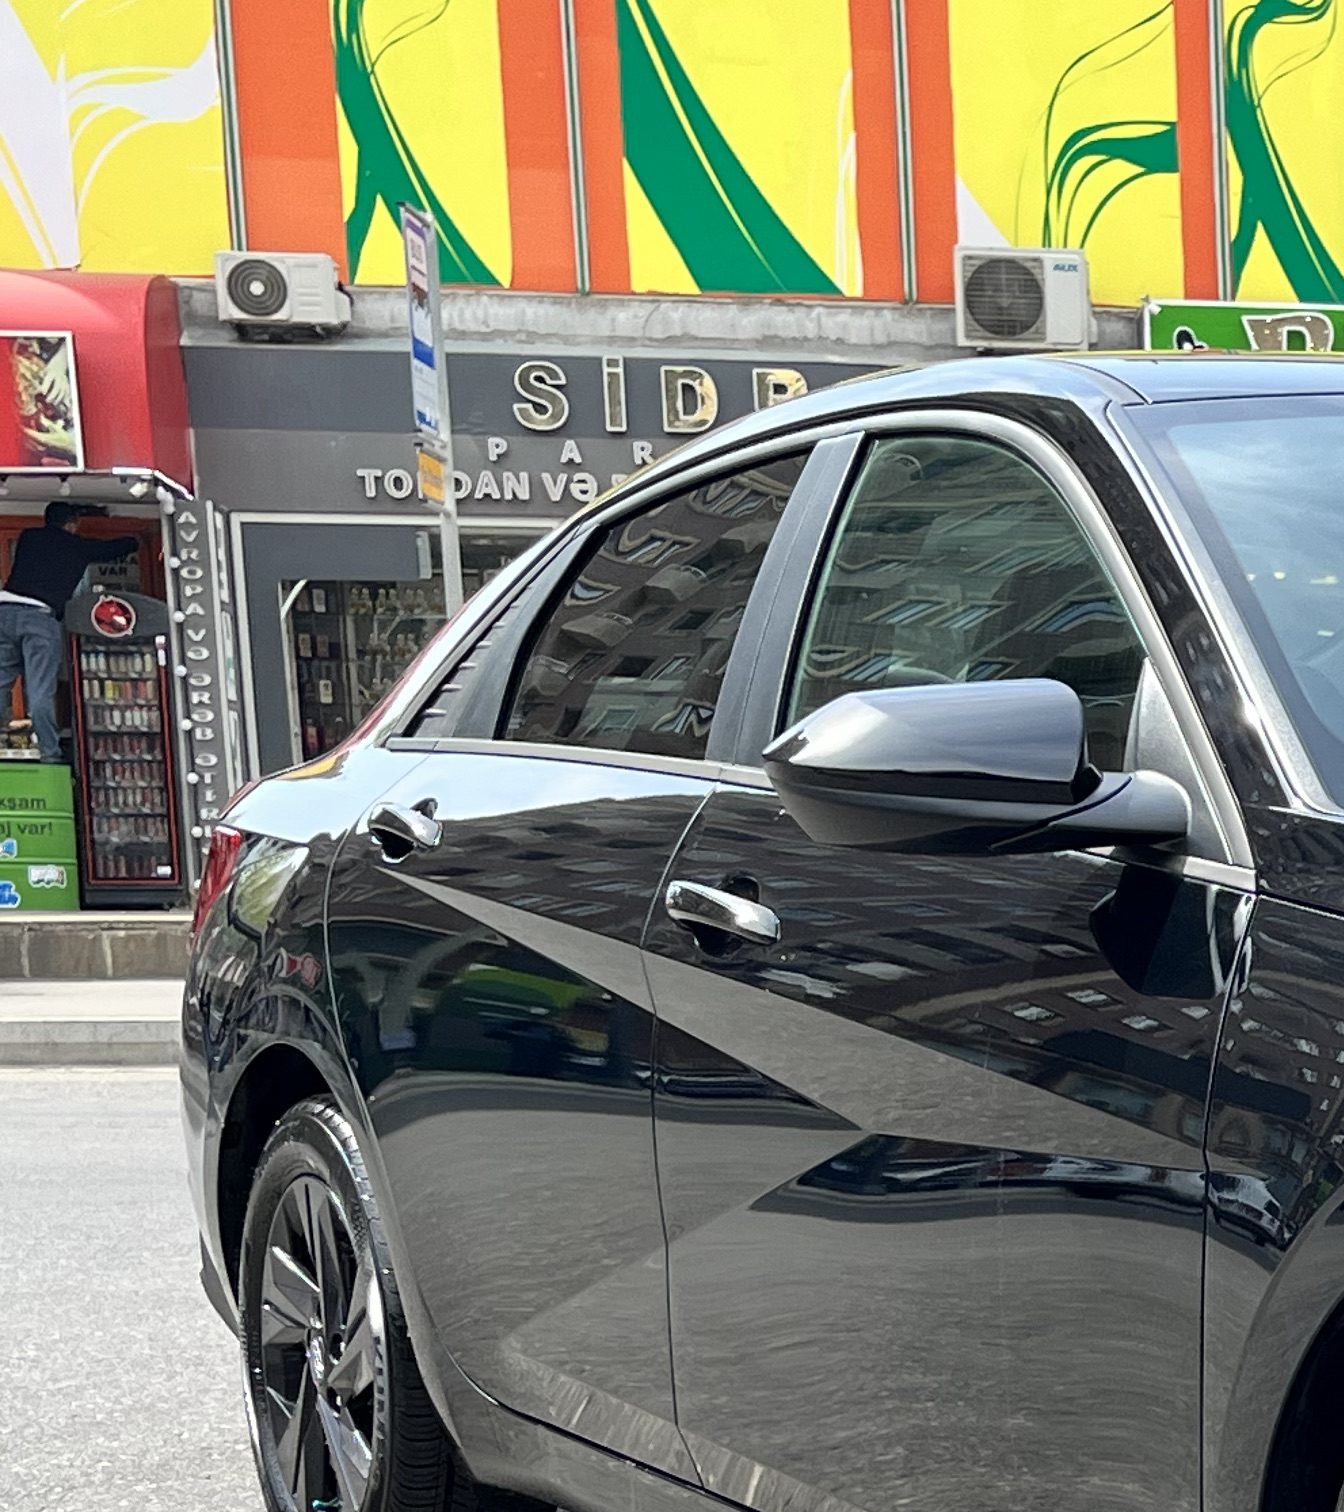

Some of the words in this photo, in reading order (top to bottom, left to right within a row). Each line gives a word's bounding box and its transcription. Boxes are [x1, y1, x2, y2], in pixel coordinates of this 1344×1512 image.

[356, 467, 531, 502] TODAN
[540, 471, 599, 503] VƏ
[177, 511, 206, 616] AVROPA
[16, 821, 53, 836] var!
